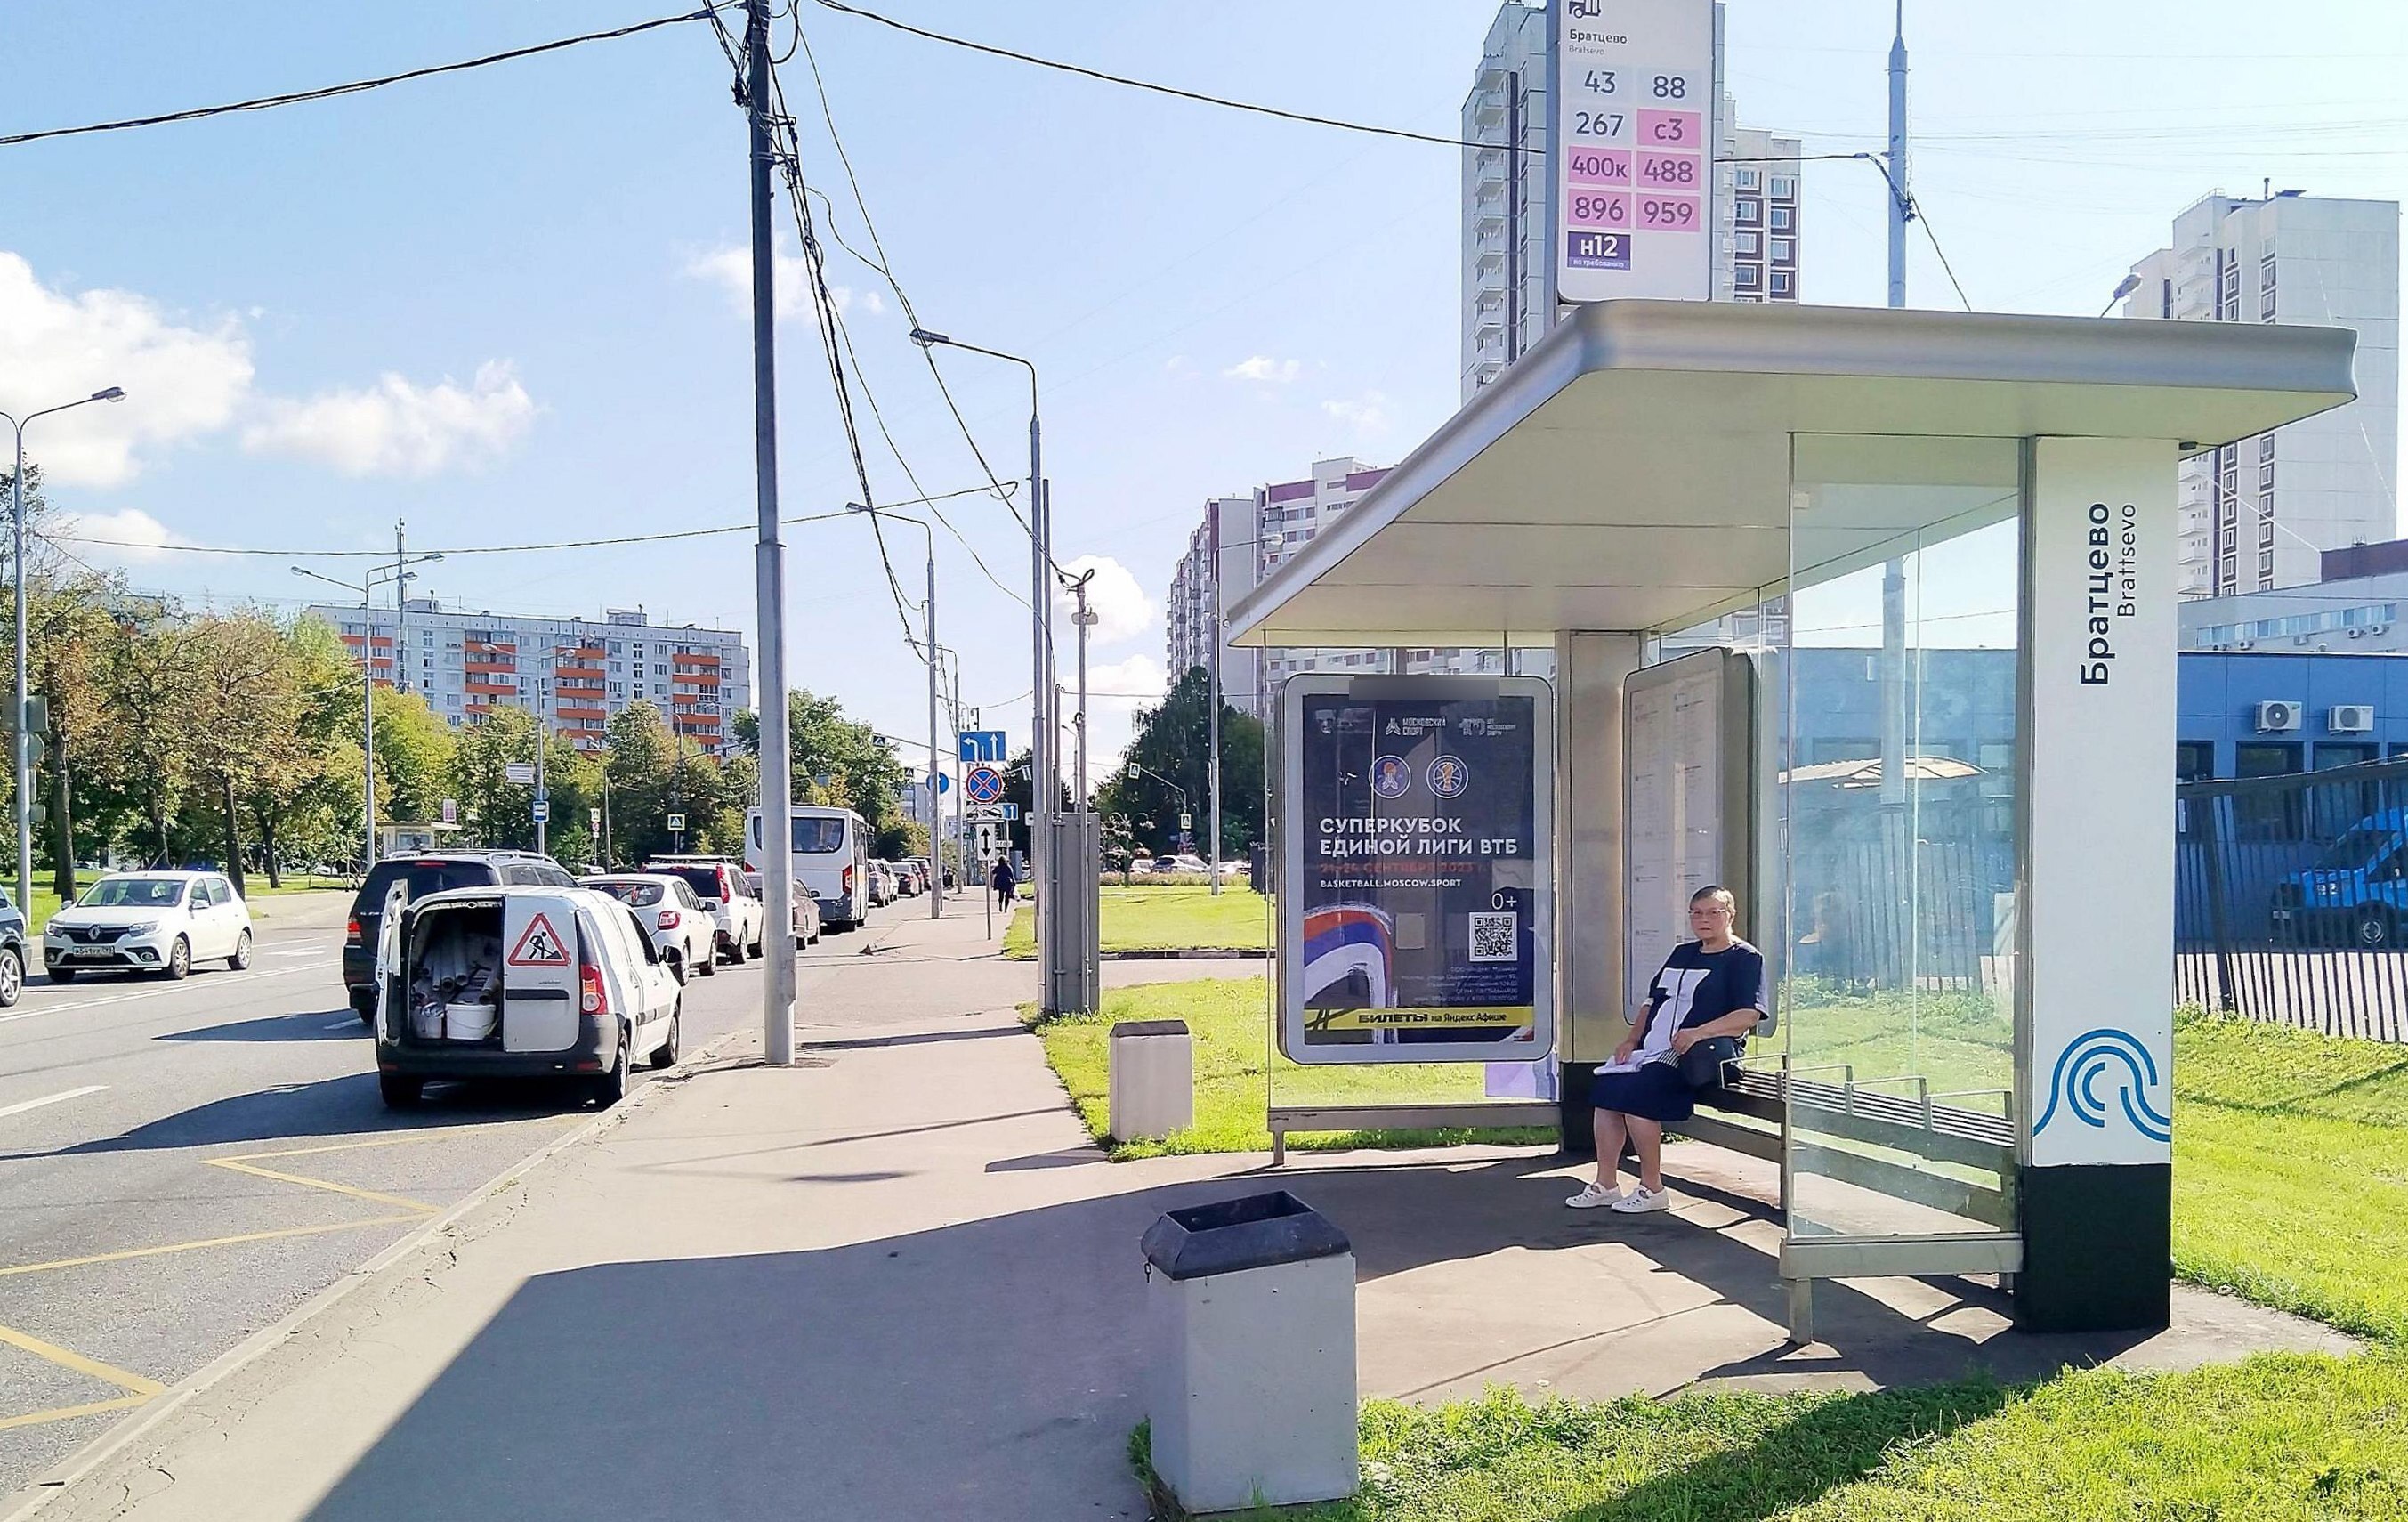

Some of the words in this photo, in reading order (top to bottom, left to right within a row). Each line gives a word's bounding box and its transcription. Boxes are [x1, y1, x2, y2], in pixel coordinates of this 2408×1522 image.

[1570, 28, 1628, 45] Братцево
[1584, 70, 1616, 94] 43
[1652, 75, 1685, 99] 88
[1575, 111, 1624, 137] 267
[1572, 155, 1628, 179] 400к
[1644, 158, 1693, 183] 488
[1574, 196, 1624, 222] 896
[1644, 200, 1693, 225] 959
[2117, 504, 2136, 616] Brattsevo
[2081, 503, 2115, 684] Братцево
[1320, 818, 1462, 834] СУПЕРКУБОК
[1321, 835, 1410, 858] ЕДИНОЙ
[1418, 839, 1473, 855] ЛИГИ
[1480, 839, 1518, 854] ВТБ
[1320, 878, 1461, 888] BASKETBALL.MOSCOW.SPORT
[1491, 893, 1517, 910] 0+
[1358, 1014, 1428, 1024] БИЛЕТЫ
[1443, 1013, 1475, 1024] Яндекс
[1475, 1013, 1507, 1023] Афише
